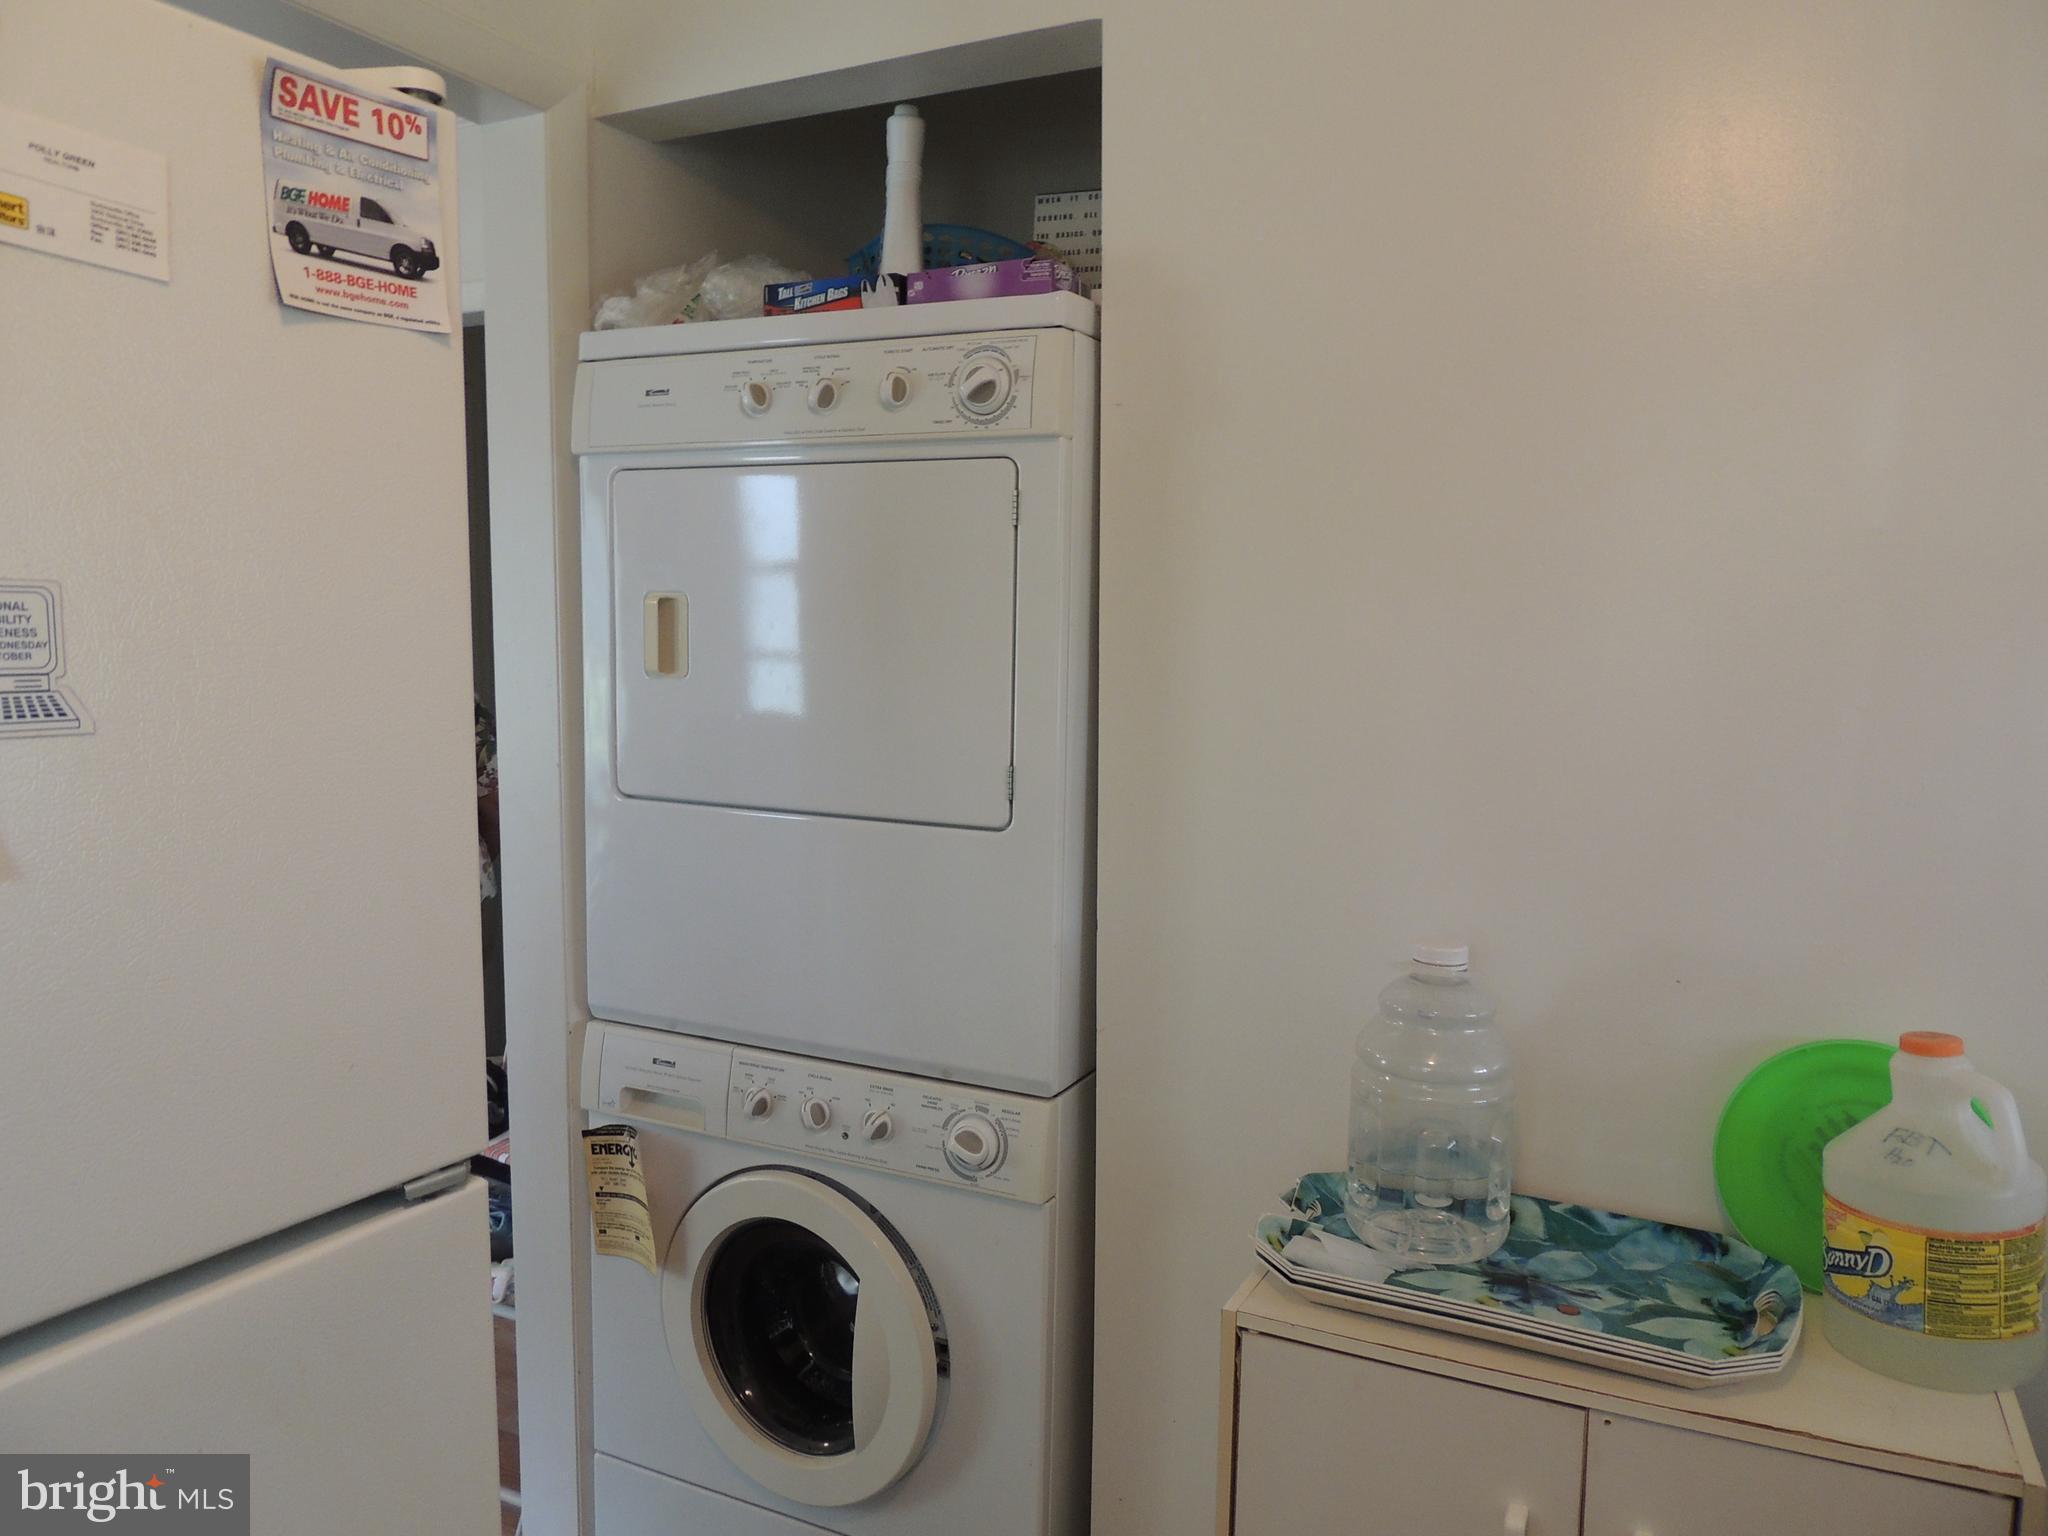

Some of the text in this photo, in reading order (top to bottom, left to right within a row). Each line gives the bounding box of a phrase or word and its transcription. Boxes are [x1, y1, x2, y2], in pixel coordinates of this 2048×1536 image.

[278, 75, 360, 128] SAVE
[371, 107, 423, 141] 10%
[28, 141, 61, 157] POLLY
[62, 151, 96, 168] GREEN
[272, 129, 321, 157] Heating
[272, 145, 332, 176] Plumbing
[280, 185, 351, 214] BGE HOME
[303, 266, 418, 299] 1-888-BGE-HOME
[793, 292, 827, 311] KITCHEN
[826, 286, 849, 302] BAGS
[0, 614, 33, 625] ILITY
